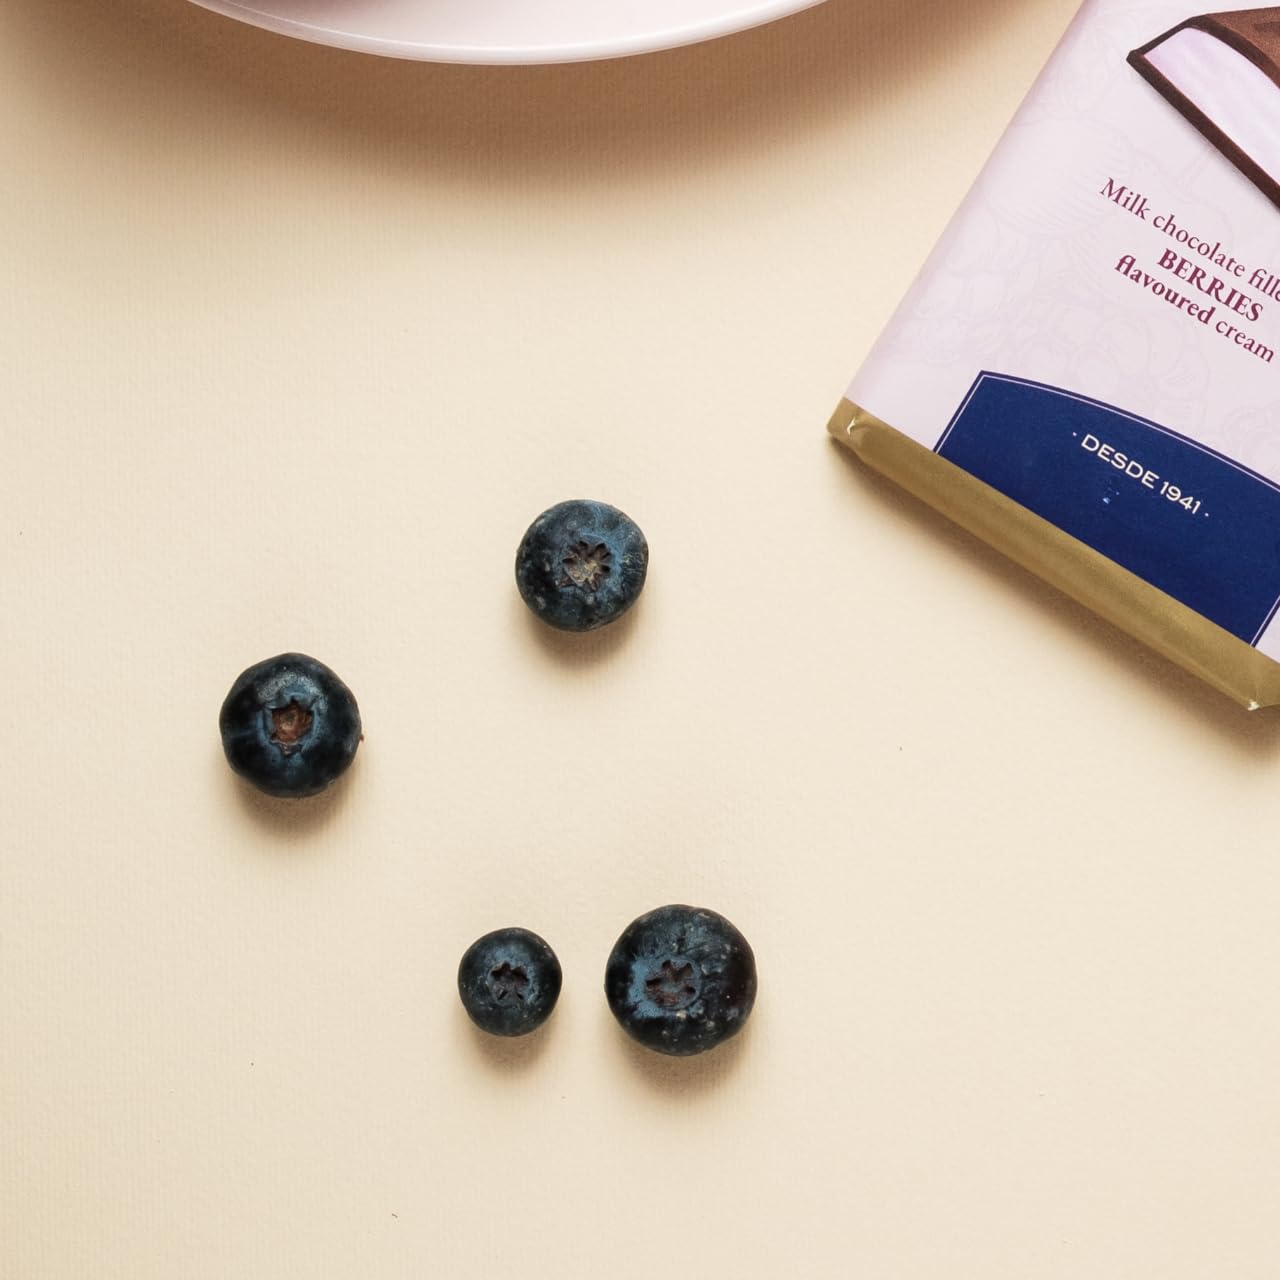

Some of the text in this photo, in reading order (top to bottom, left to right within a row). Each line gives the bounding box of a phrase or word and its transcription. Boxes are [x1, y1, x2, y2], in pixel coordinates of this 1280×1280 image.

[1101, 177, 1150, 222] Milk
[1153, 214, 1246, 280] chocolate
[1115, 254, 1275, 363] flavoured cream
[1156, 248, 1264, 322] BERRIES
[1080, 434, 1202, 515] DESDE 1941
